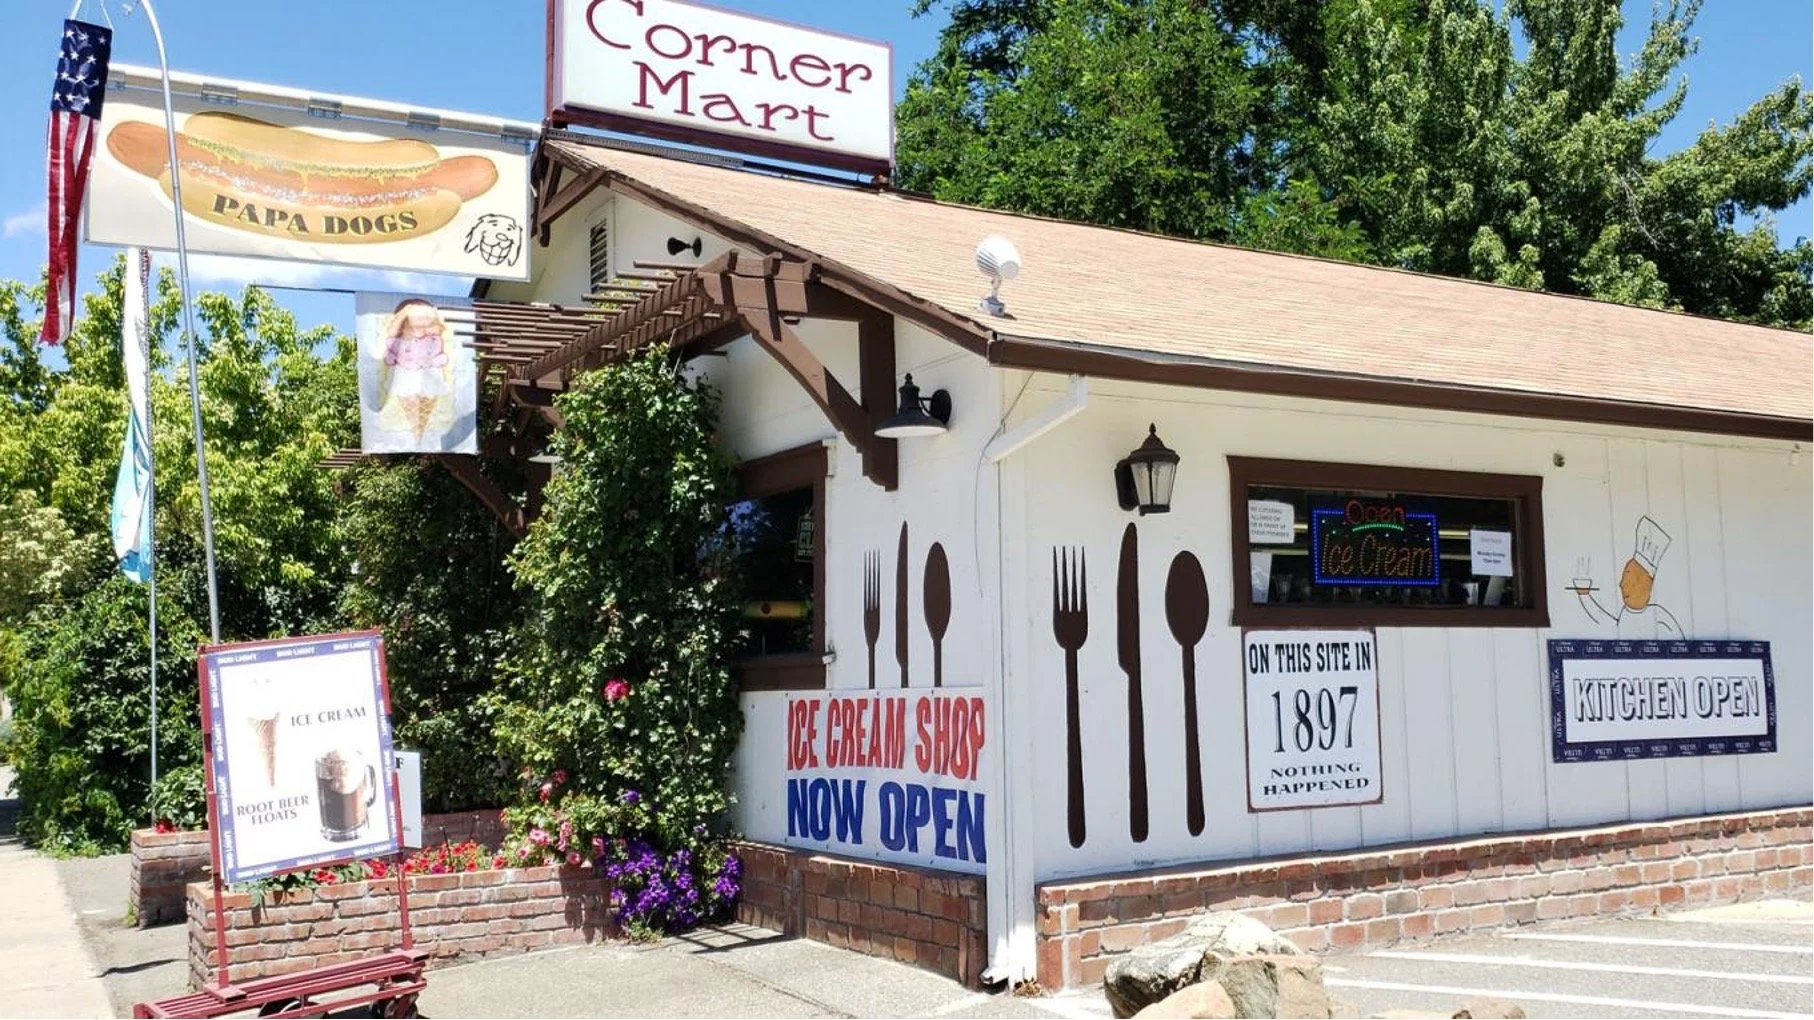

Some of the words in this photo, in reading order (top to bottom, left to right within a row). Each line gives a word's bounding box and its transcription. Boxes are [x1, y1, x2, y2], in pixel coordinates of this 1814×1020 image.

[586, 0, 872, 93] Corner
[632, 60, 834, 141] Mart
[212, 194, 310, 233] PAPA
[324, 210, 418, 235] DOGS
[1322, 534, 1353, 575] Ice
[1360, 533, 1432, 576] Cream
[1248, 643, 1269, 674] ON
[1275, 642, 1311, 673] THIS
[1316, 642, 1351, 672] SITE
[1355, 641, 1371, 671] IN
[291, 714, 313, 726] ICE
[318, 706, 367, 723] CREAM
[1271, 686, 1358, 753] 1897
[1573, 677, 1687, 722] KITCHEN
[1693, 676, 1760, 719] OPEN
[787, 699, 821, 771] ICE
[826, 697, 906, 770] CREAM
[914, 696, 986, 781] SHOP
[1263, 777, 1369, 796] HAPPENED
[1271, 762, 1360, 778] NOTHING
[236, 800, 274, 816] ROOT
[279, 795, 310, 809] BEER
[251, 809, 297, 825] FLOATS
[787, 777, 866, 844] NOW
[878, 780, 987, 864] OPEN
